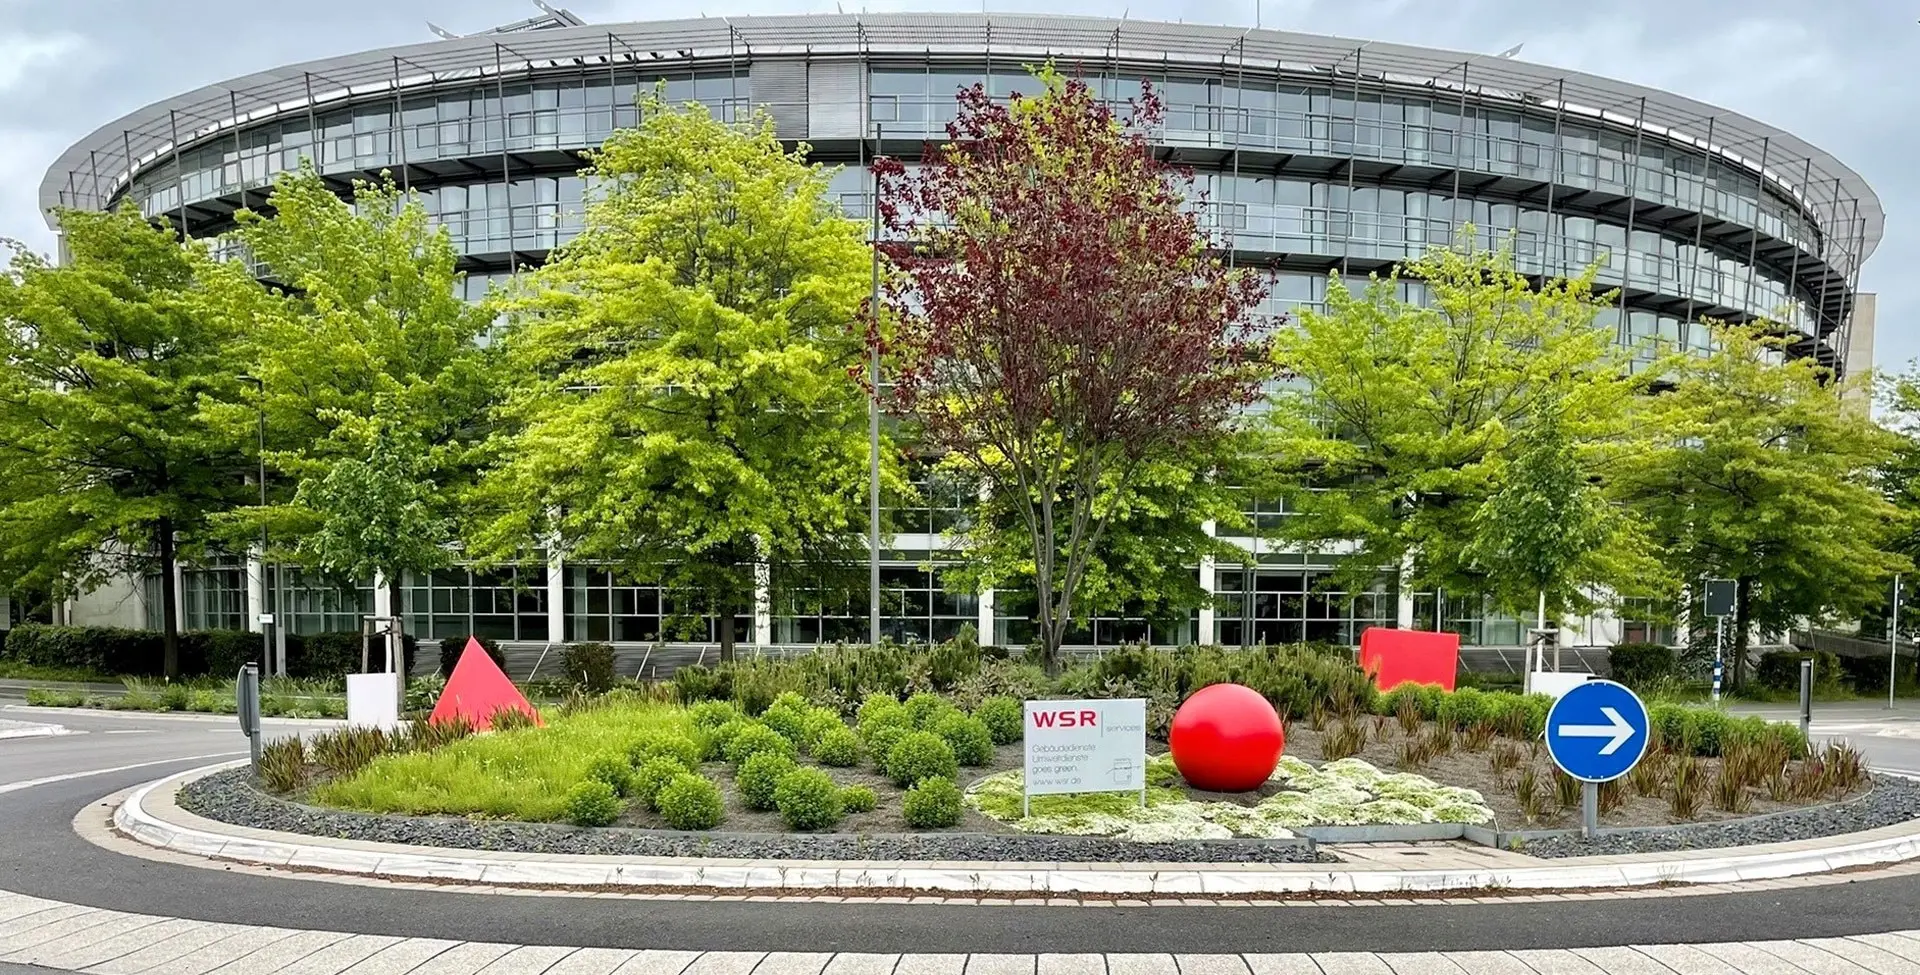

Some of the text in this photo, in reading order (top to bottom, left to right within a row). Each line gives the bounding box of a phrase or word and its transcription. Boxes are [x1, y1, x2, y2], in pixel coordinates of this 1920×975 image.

[1032, 711, 1096, 727] WSR
[1106, 724, 1141, 732] services
[1032, 754, 1089, 763] Umweltdienste
[1032, 765, 1053, 775] goes
